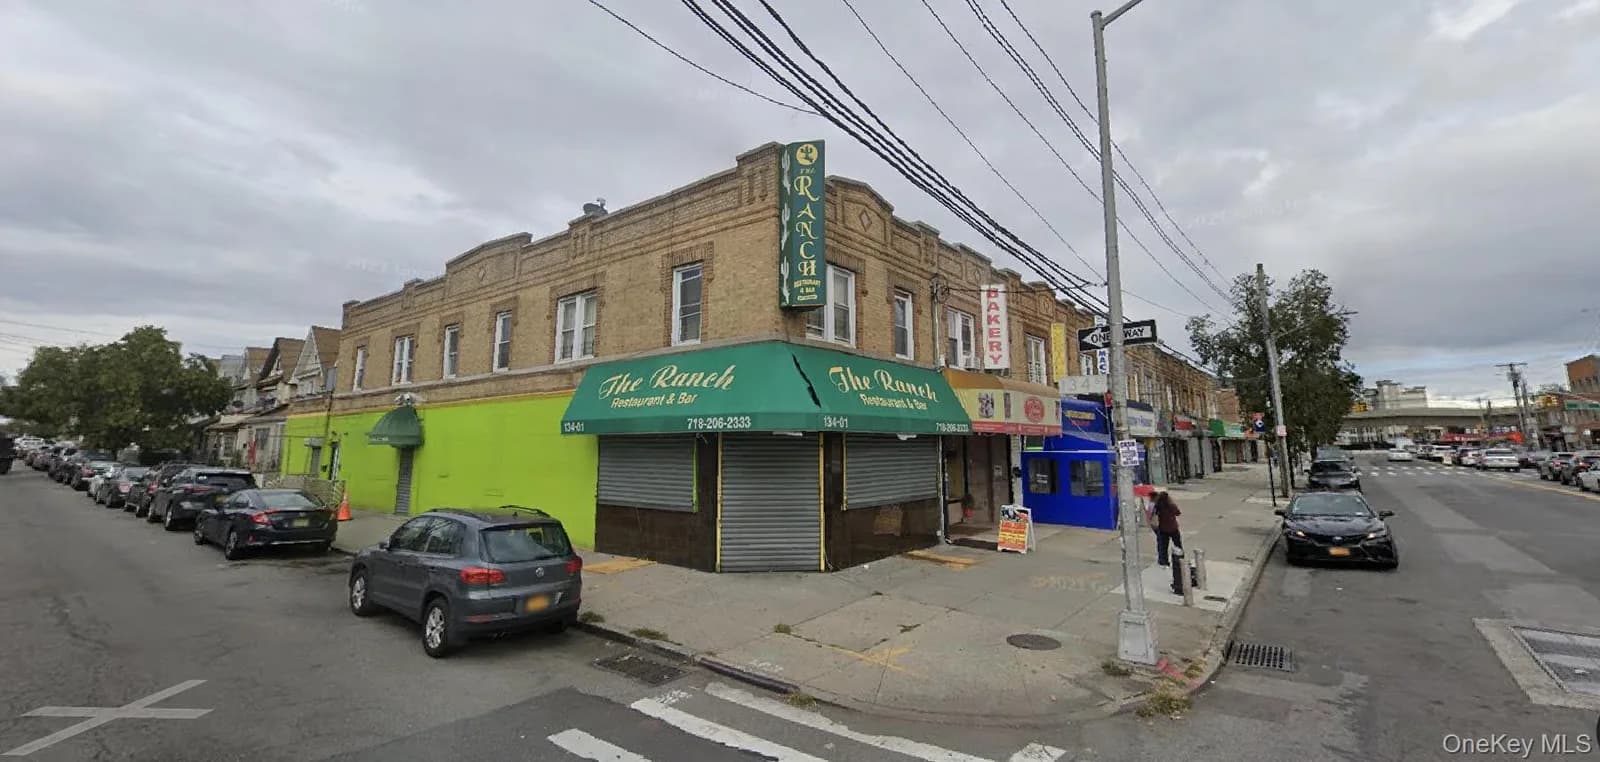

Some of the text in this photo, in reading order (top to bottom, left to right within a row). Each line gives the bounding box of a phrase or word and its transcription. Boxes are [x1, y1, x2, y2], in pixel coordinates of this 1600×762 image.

[793, 175, 819, 276] RANCH
[986, 288, 1003, 365] BAKERY
[1123, 328, 1144, 338] WAY
[599, 365, 736, 399] The Ranch
[828, 366, 938, 402] The Ranch
[611, 392, 698, 409] Restaurant & Bar
[860, 393, 907, 408] Restaurant
[564, 421, 584, 432] 134-01
[687, 416, 752, 430] 718-206-2333
[824, 415, 848, 429] 134-01
